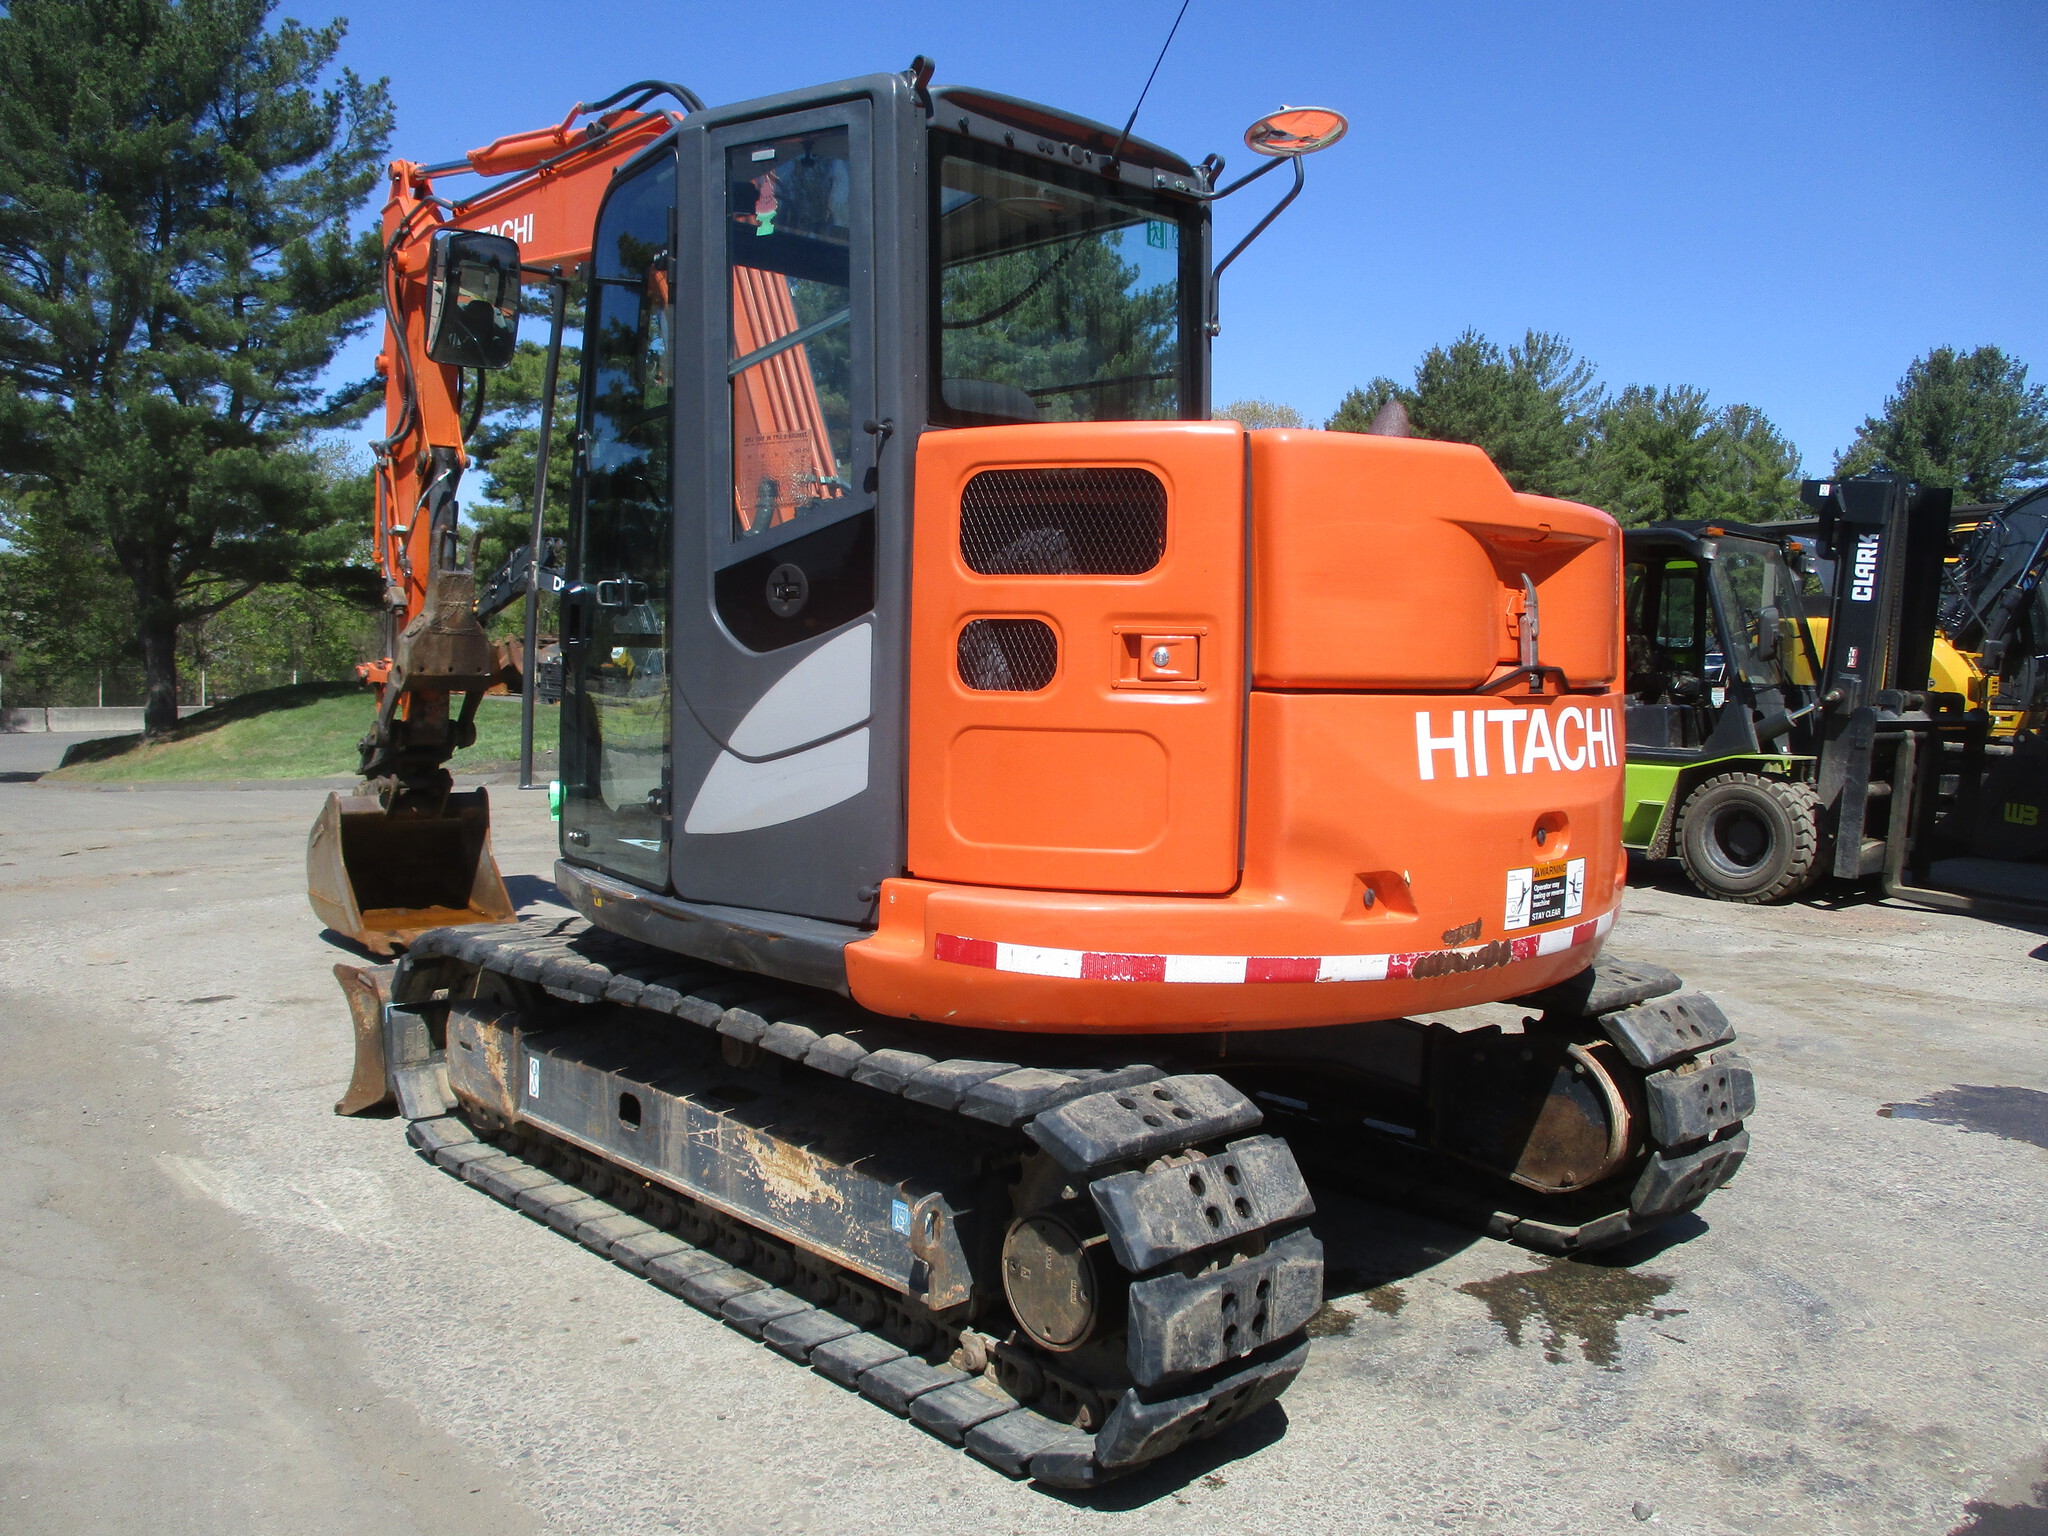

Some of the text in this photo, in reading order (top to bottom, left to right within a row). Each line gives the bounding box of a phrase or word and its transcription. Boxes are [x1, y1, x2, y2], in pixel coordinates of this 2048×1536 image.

[1851, 533, 1880, 602] CLARK
[1415, 706, 1618, 780] HITACHI
[1540, 864, 1566, 876] WARNING
[1533, 883, 1552, 892] Operator
[1533, 899, 1550, 908] machine
[1531, 908, 1561, 921] STAY CLEAR
